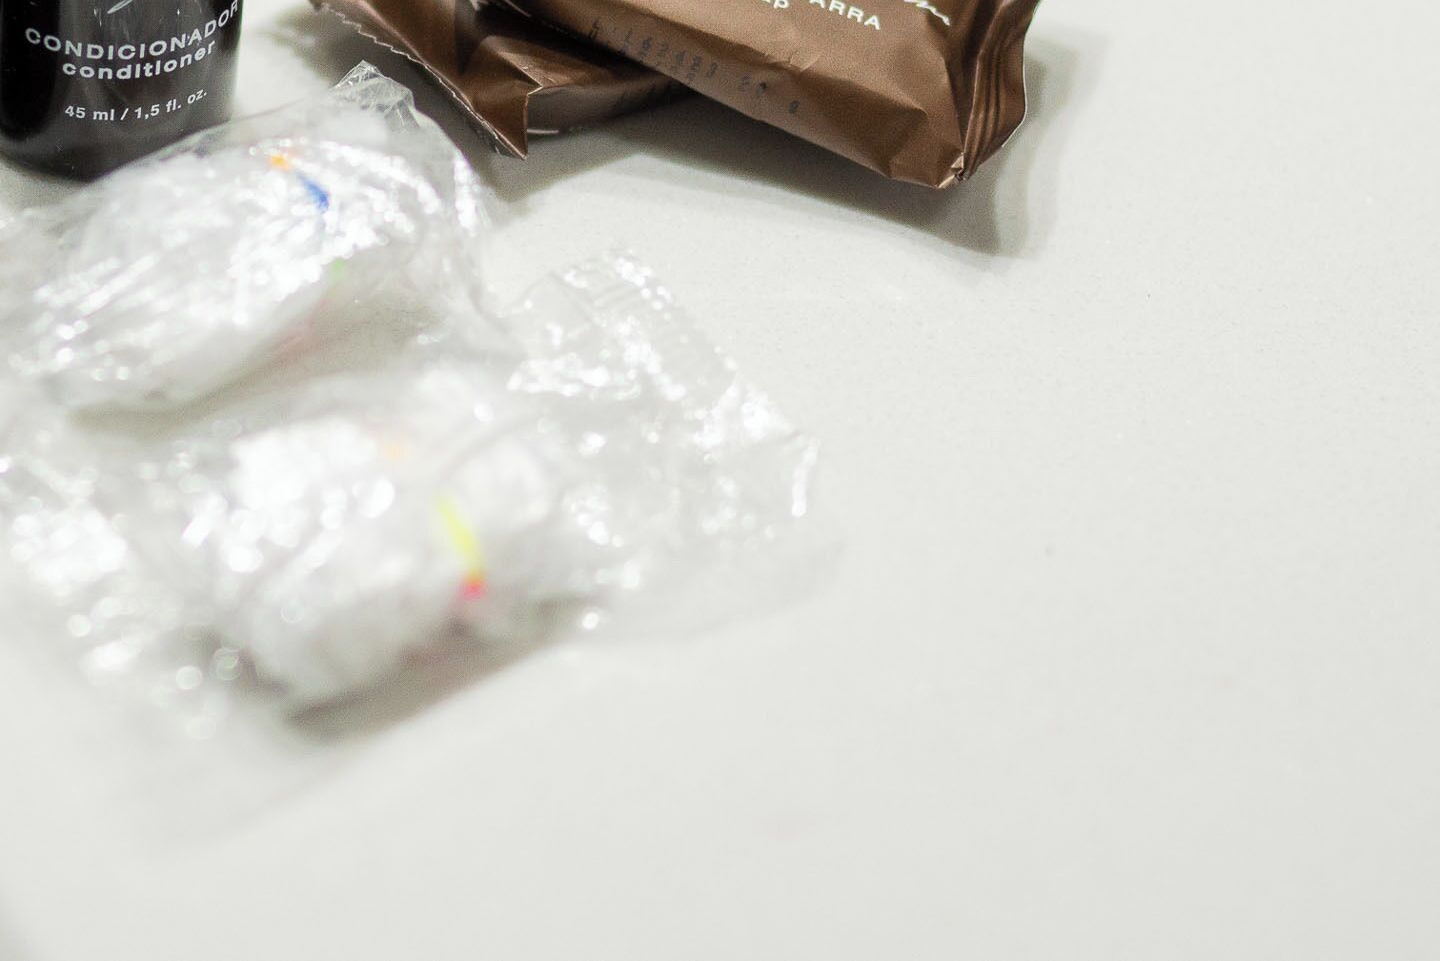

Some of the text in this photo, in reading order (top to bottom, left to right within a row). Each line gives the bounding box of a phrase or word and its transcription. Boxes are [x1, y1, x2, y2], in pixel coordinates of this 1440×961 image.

[62, 40, 216, 81] conditioner
[64, 88, 208, 122] 45 ml / 1,5 fl. oz.
